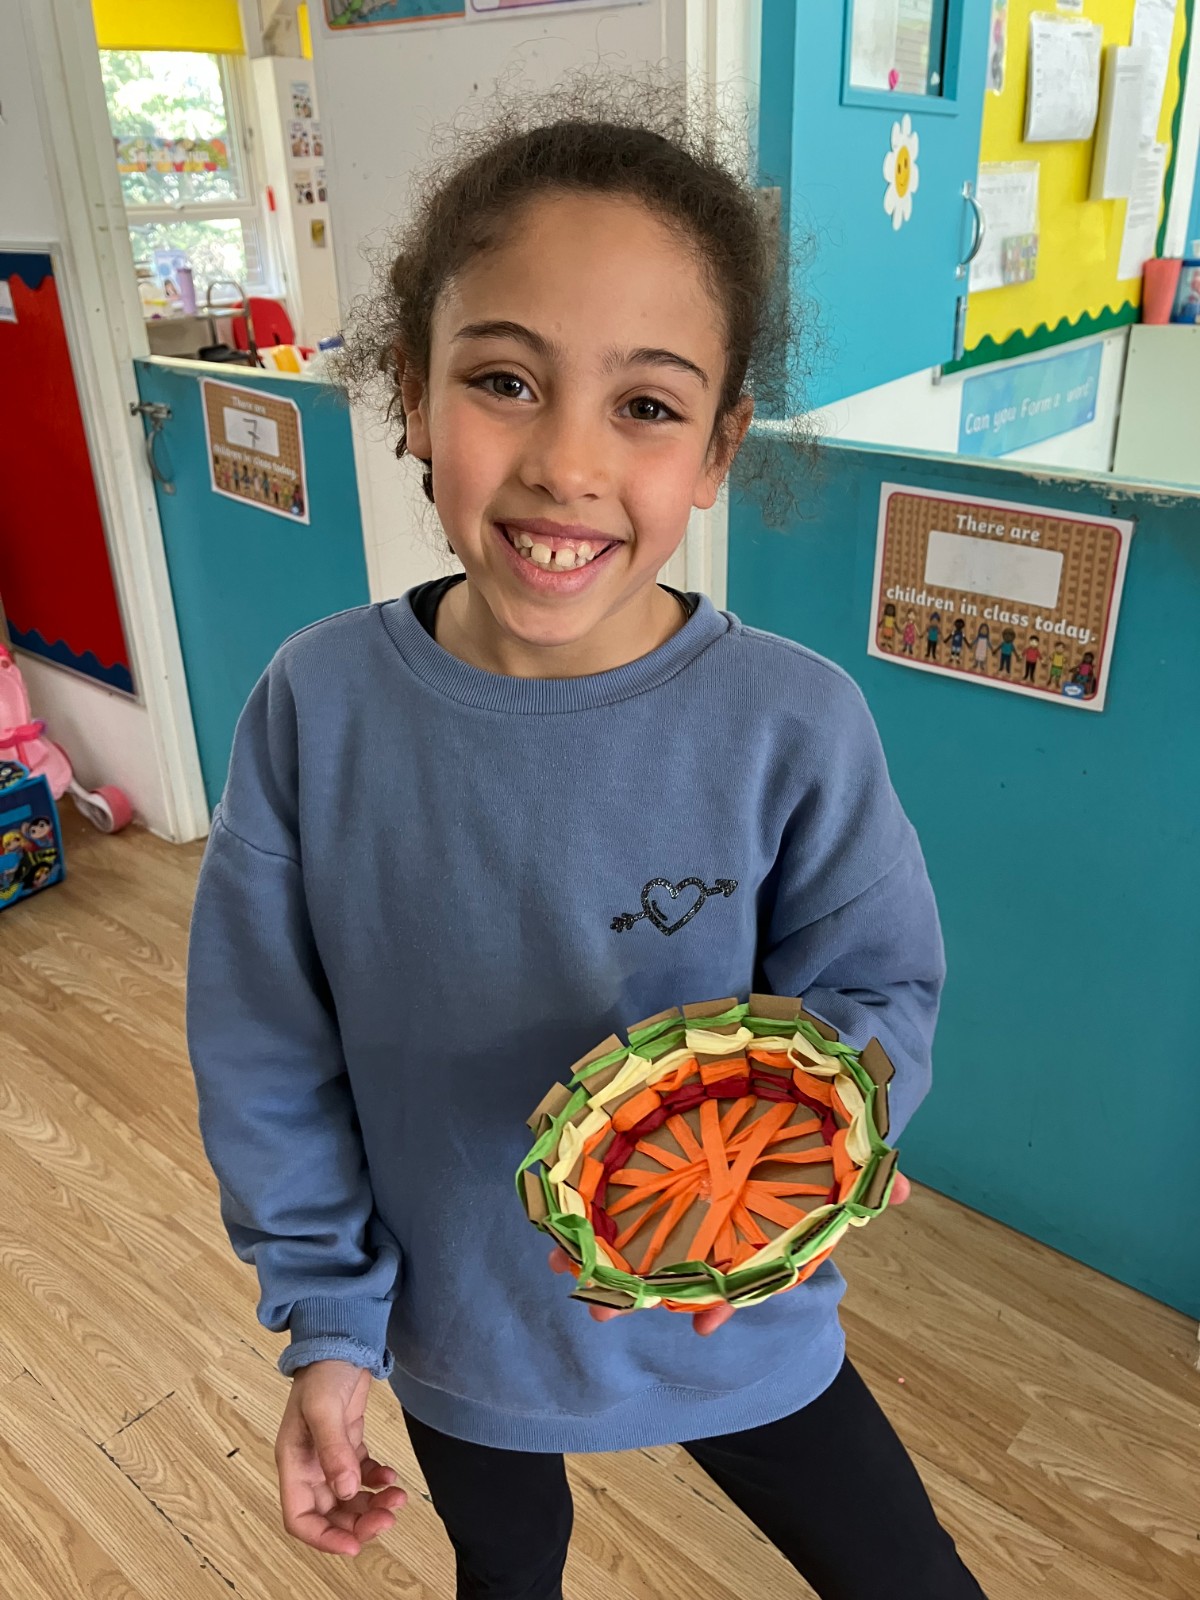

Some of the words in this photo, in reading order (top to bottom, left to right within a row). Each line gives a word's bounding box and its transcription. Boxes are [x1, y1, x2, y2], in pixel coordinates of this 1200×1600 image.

[242, 417, 261, 449] 7
[965, 412, 990, 435] Can
[993, 406, 1017, 433] you
[1020, 397, 1052, 419] Form
[956, 514, 1005, 536] There
[1010, 526, 1041, 543] are
[886, 584, 954, 611] children
[960, 599, 978, 616] in
[983, 604, 1029, 627] class
[1035, 614, 1097, 645] today.
